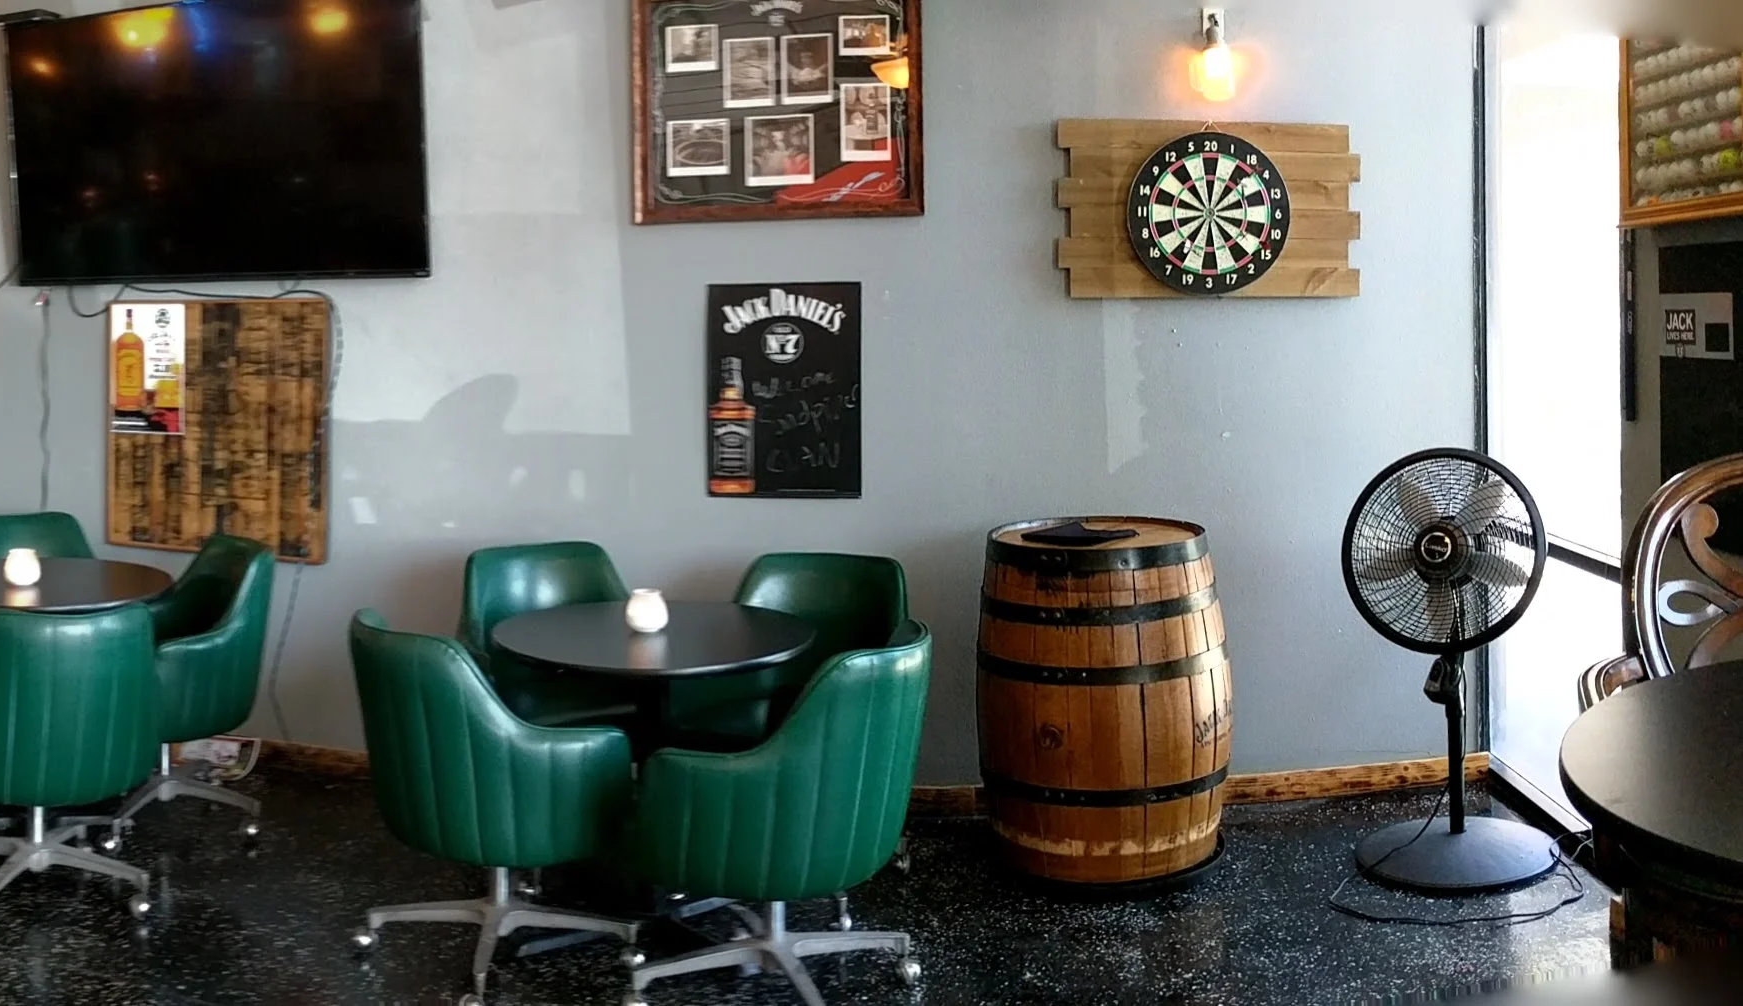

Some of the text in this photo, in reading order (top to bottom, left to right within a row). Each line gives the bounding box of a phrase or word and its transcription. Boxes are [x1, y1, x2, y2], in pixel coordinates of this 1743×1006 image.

[1187, 141, 1195, 152] 5
[1203, 141, 1218, 151] 20
[1230, 144, 1235, 154] 1
[1165, 152, 1177, 162] 12
[1246, 154, 1258, 165] 18
[1152, 165, 1160, 176] 9
[1263, 169, 1270, 180] 4
[1139, 185, 1151, 196] 14
[1270, 188, 1282, 199] 13
[1137, 206, 1147, 217] 11
[1275, 208, 1282, 220] 6
[1141, 228, 1150, 239] 8
[1270, 229, 1282, 240] 10
[1149, 247, 1161, 258] 16
[1260, 249, 1272, 260] 15
[1165, 265, 1173, 276] 7
[1247, 263, 1255, 274] 2
[1182, 274, 1194, 285] 19
[1205, 277, 1213, 289] 3
[1226, 274, 1238, 285] 17
[721, 288, 847, 334] JACK DANIEL'S
[1666, 312, 1694, 330] JACK
[1666, 331, 1680, 341] LIVES
